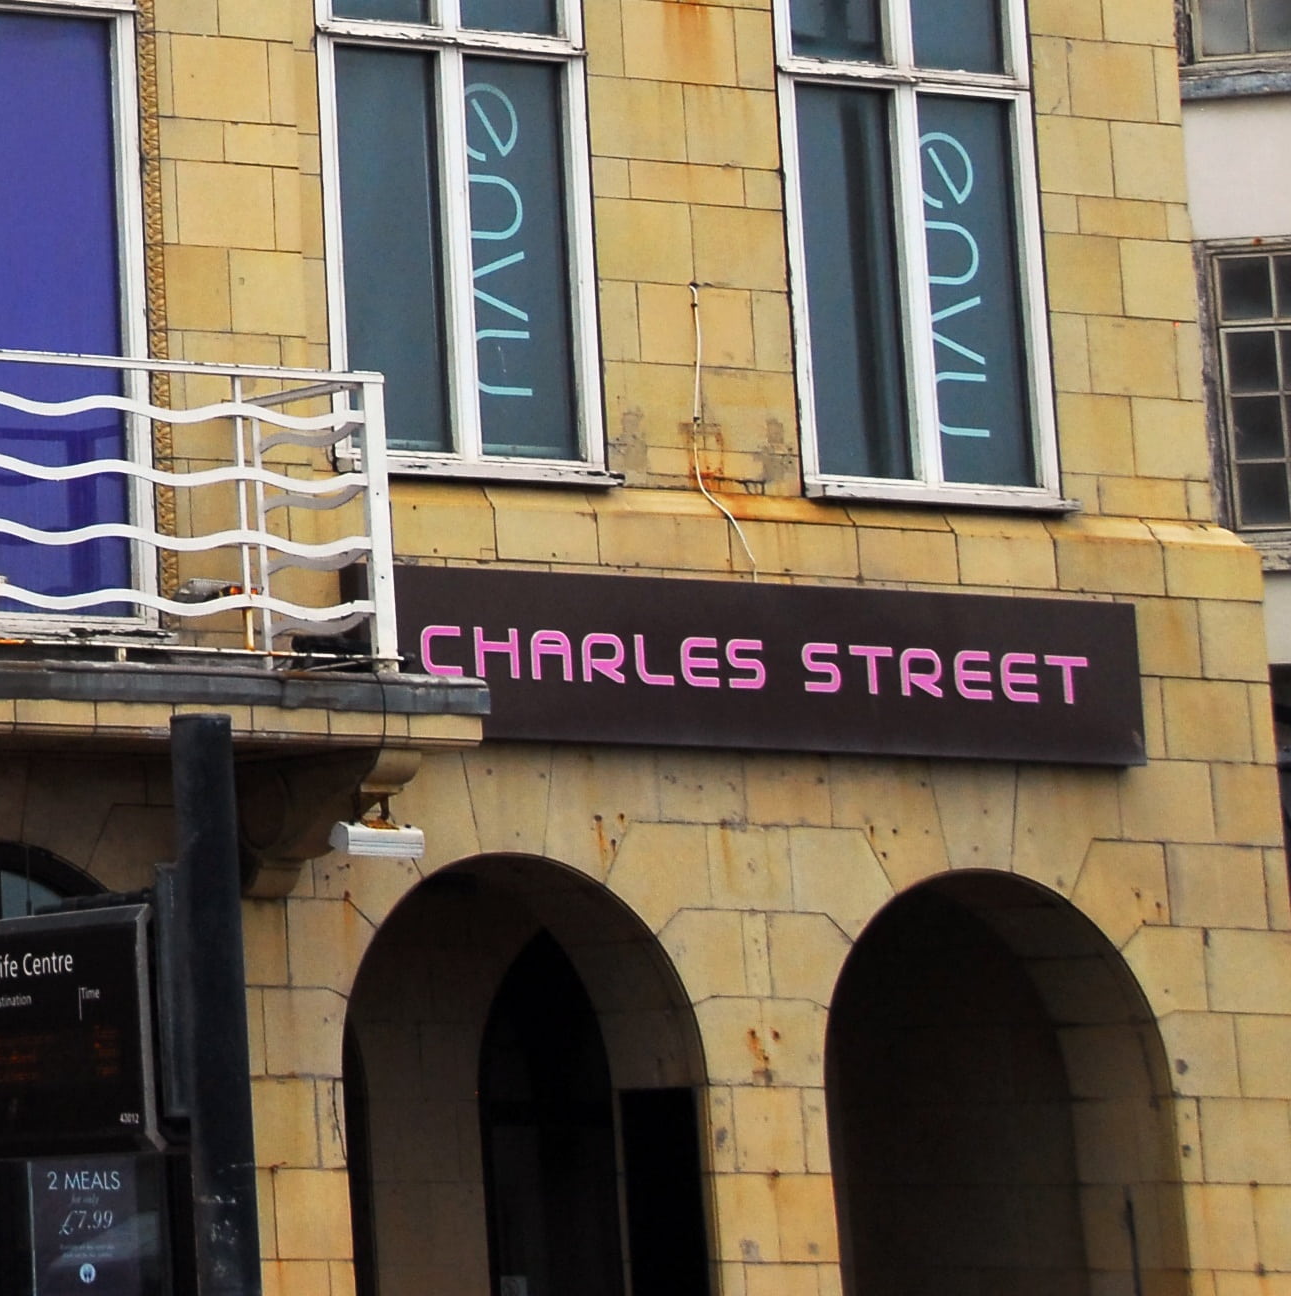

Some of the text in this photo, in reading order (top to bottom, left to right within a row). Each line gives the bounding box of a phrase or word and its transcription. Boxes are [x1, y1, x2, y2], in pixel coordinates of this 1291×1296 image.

[420, 625, 1088, 704] CHARLES STREET
[22, 951, 73, 976] Centre
[81, 987, 100, 1000] Time
[47, 1171, 121, 1190] 2 MEALS
[59, 1210, 113, 1235] £7.99
